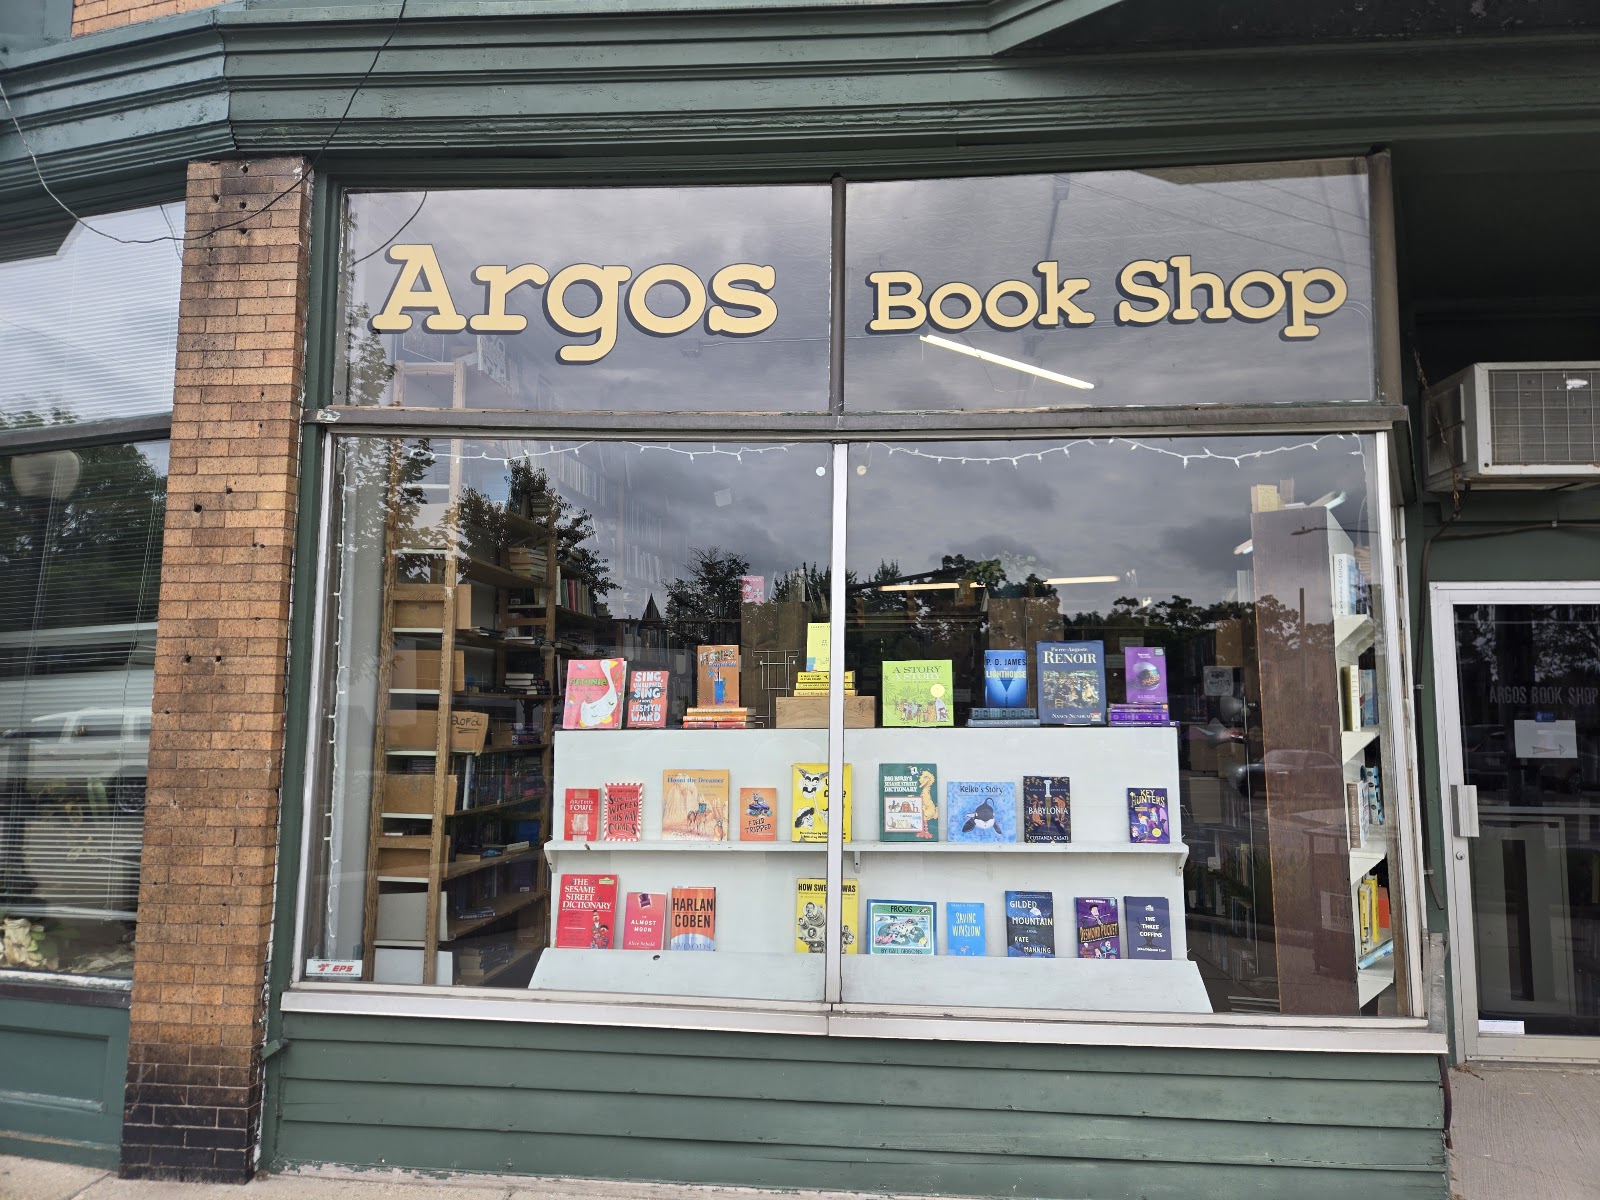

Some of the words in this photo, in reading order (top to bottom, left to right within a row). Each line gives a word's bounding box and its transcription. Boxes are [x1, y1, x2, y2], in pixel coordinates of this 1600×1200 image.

[368, 243, 779, 364] Argos
[865, 261, 1096, 334] Book
[1115, 255, 1348, 341] Shop
[1043, 650, 1096, 664] RENOIR
[634, 671, 664, 682] SING,
[986, 670, 1026, 678] LIGHTHOUSE
[569, 678, 607, 687] PETUNIA
[634, 688, 661, 698] SING
[1490, 686, 1527, 704] ARGOS
[1532, 686, 1563, 704] BOOK
[1568, 687, 1599, 705] SHOP
[631, 704, 661, 712] JESMYN
[631, 712, 661, 722] WARD
[986, 786, 1004, 796] Story
[1131, 796, 1165, 808] HUNTERS
[609, 802, 638, 814] WICKED
[1028, 806, 1068, 815] BABYLONIA
[624, 810, 636, 822] WAY
[608, 823, 636, 834] COMES
[745, 824, 772, 834] TRIPPED
[798, 883, 813, 892] HOW
[814, 884, 826, 892] SWE
[842, 884, 856, 892] WAS
[562, 900, 612, 910] DICTIONARY
[672, 898, 714, 912] HARLAN
[1010, 900, 1037, 908] GILDED
[674, 914, 710, 928] COBEN
[956, 912, 976, 924] SAVING
[1012, 916, 1053, 926] MOUNTAIN
[952, 924, 980, 937] WINSLOW
